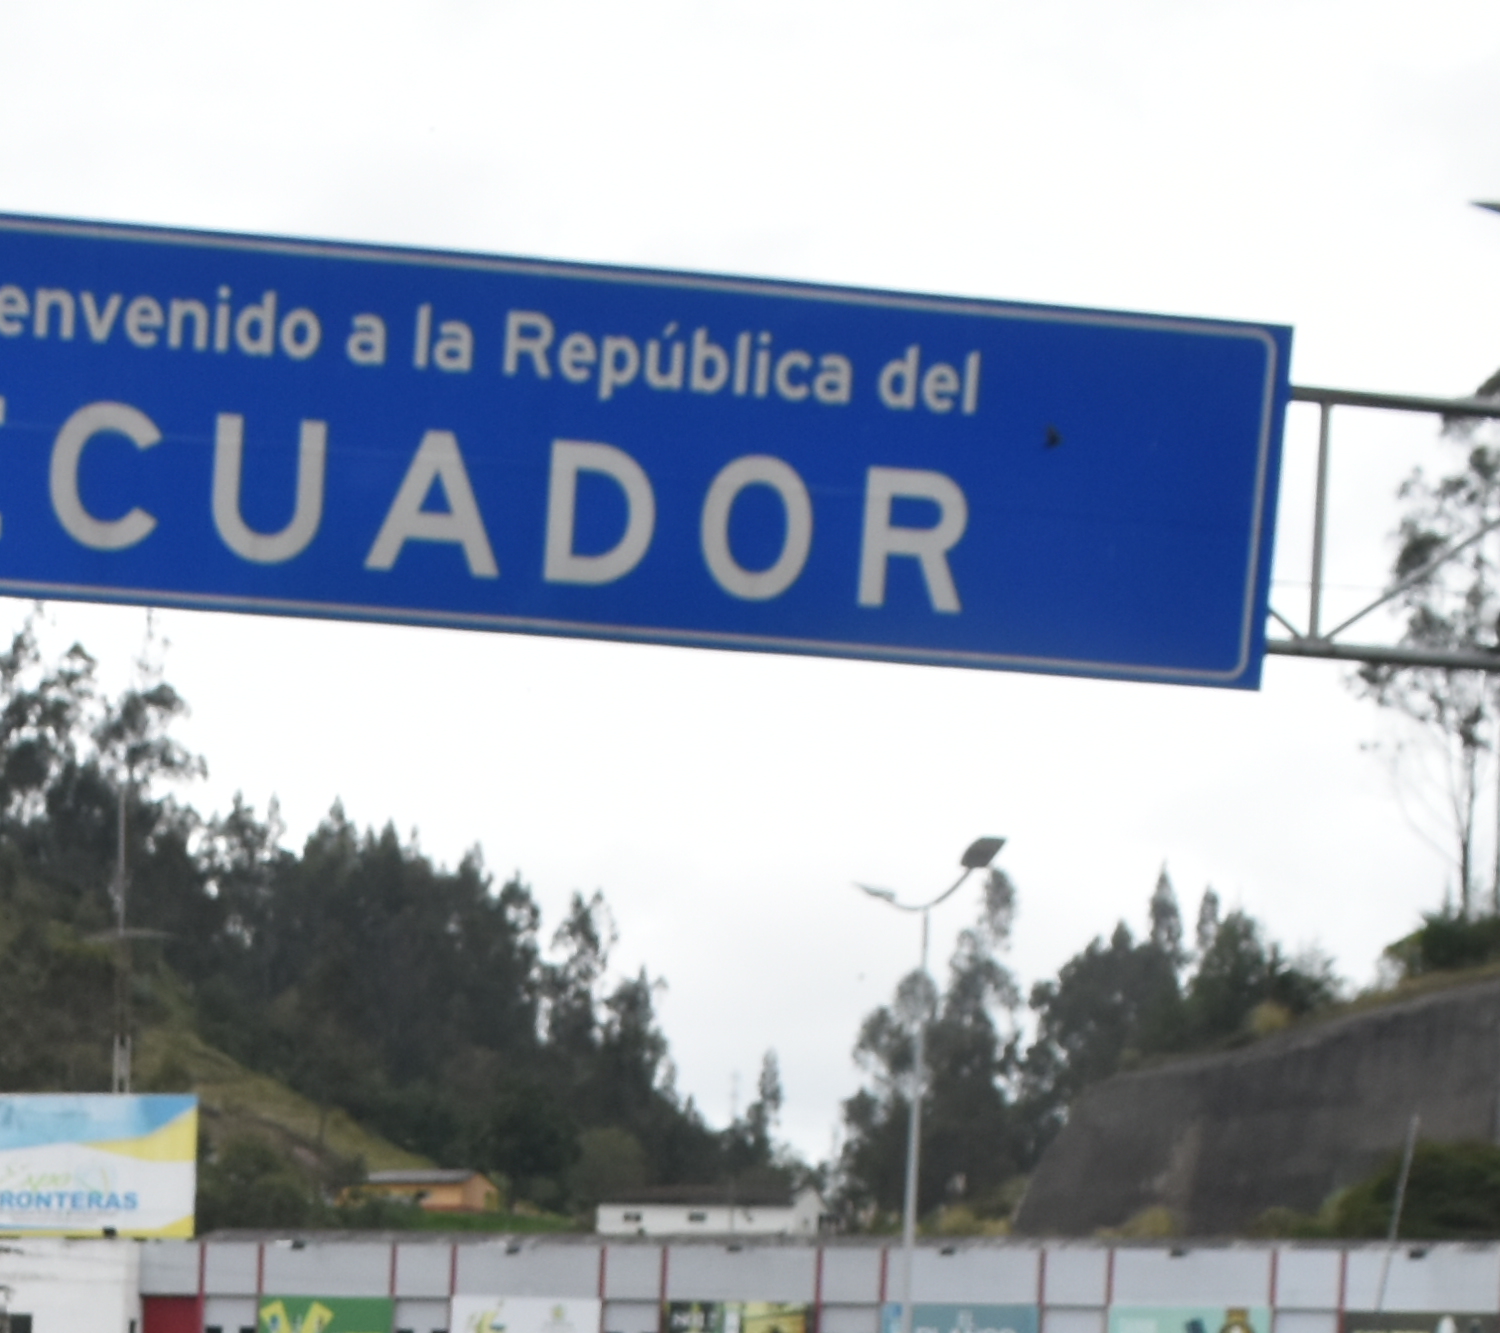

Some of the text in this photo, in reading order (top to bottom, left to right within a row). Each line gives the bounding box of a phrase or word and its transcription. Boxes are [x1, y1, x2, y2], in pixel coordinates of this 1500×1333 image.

[347, 313, 387, 364] a
[414, 304, 474, 371] la
[504, 310, 853, 403] República
[879, 345, 981, 414] del
